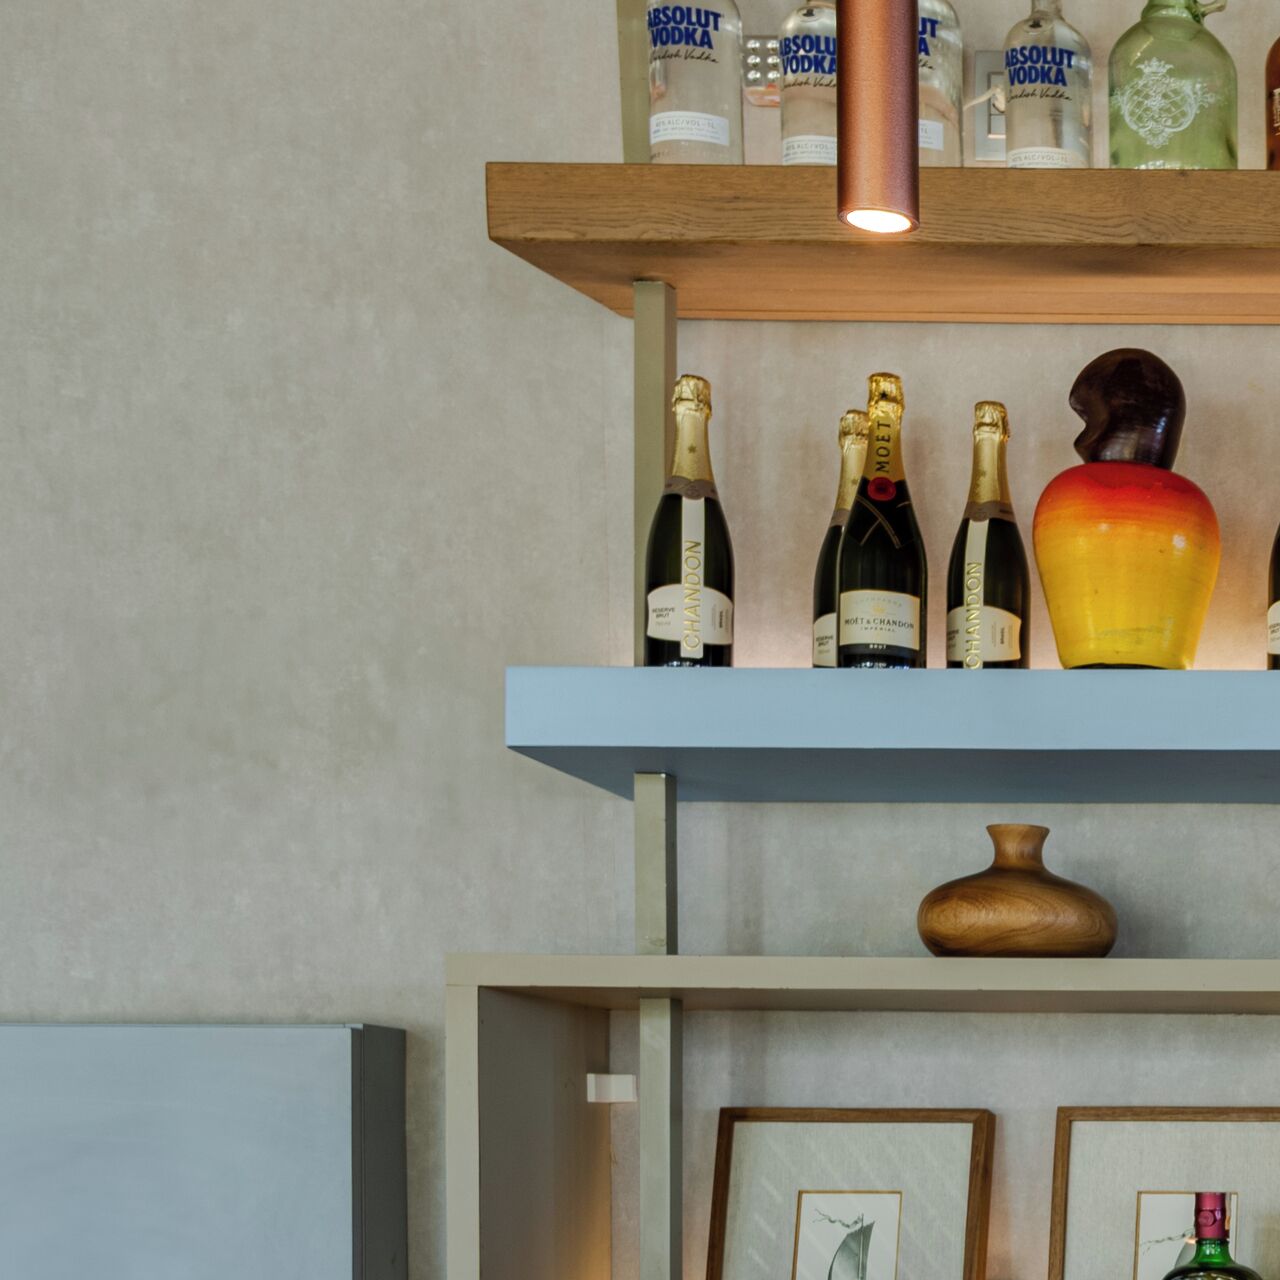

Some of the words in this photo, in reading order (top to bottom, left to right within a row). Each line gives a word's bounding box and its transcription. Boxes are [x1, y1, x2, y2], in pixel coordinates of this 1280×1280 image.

[648, 6, 721, 31] ABSOLUT
[651, 26, 713, 50] VODKA
[780, 34, 837, 57] ABSOLU
[1005, 45, 1075, 69] ABSOLUT
[1008, 65, 1067, 87] VODKA
[684, 540, 701, 651] CHANDON
[873, 618, 914, 629] CHANDON
[965, 562, 982, 669] CHANDON
